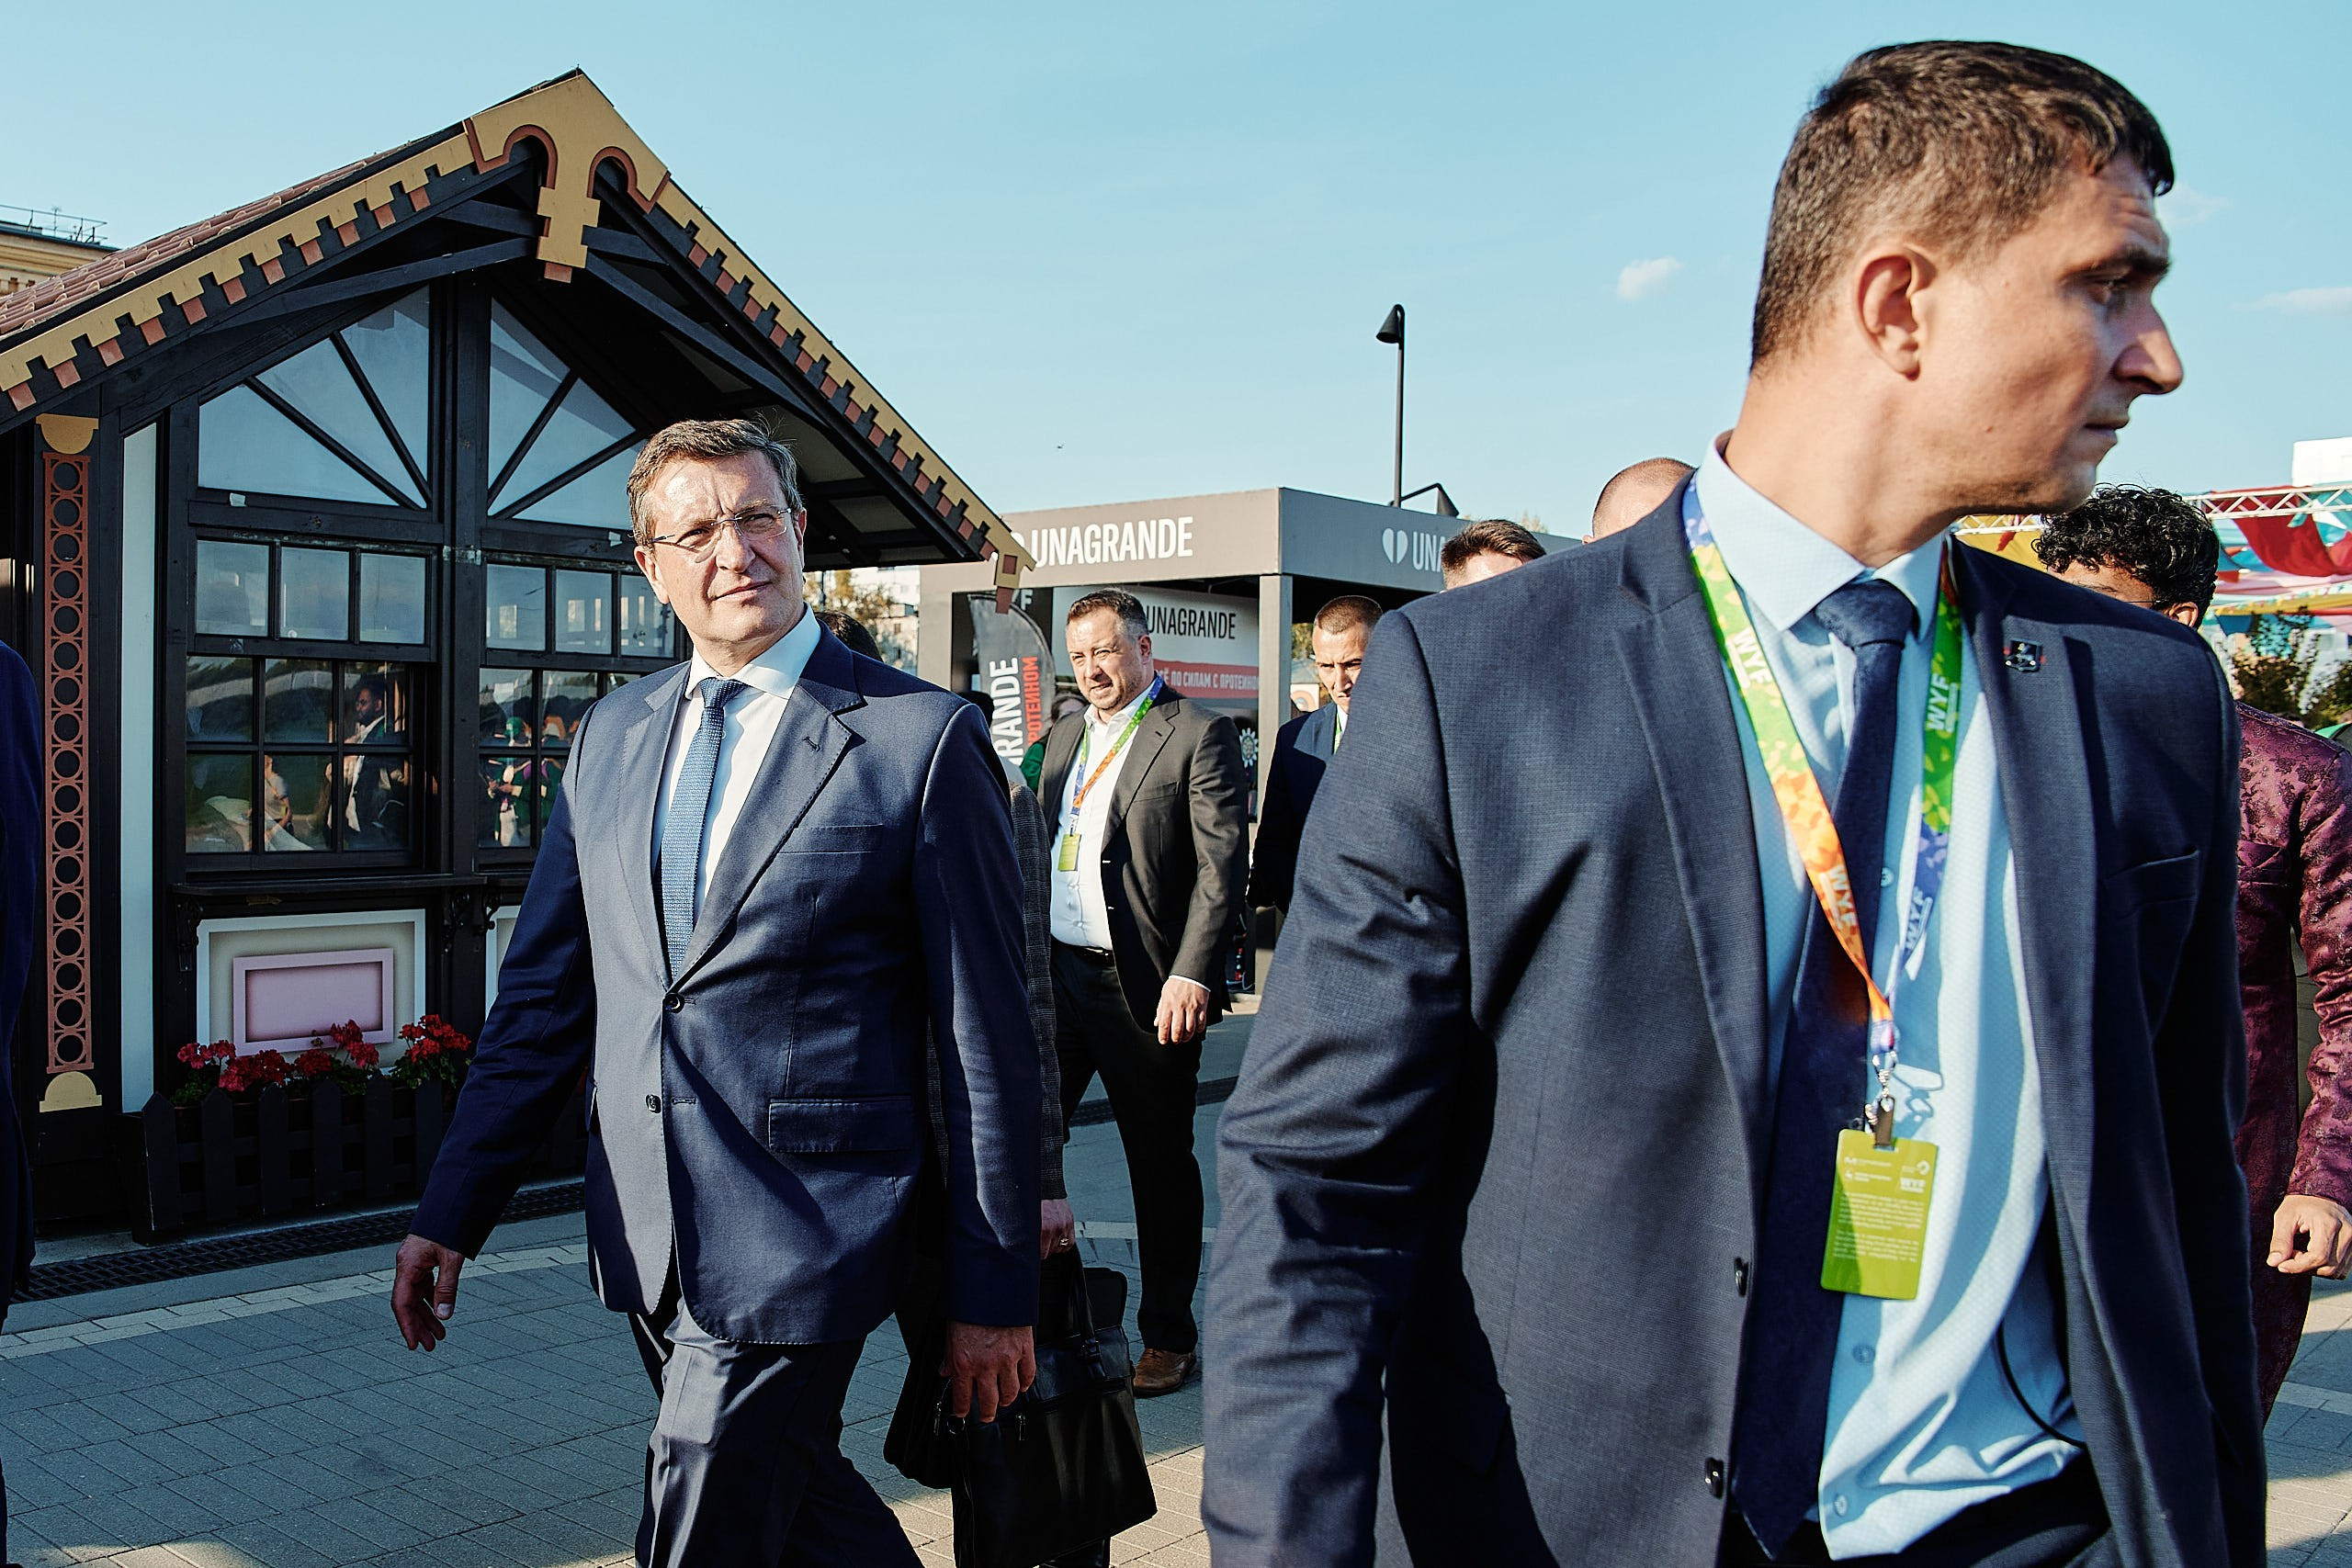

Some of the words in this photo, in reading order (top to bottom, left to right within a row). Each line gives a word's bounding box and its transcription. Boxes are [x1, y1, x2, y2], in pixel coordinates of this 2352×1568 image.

[1032, 516, 1193, 568] UNAGRANDE
[1146, 606, 1236, 639] UNAGRANDE
[1219, 673, 1259, 691] ПРОТЕИНО
[1733, 626, 1773, 684] WYF
[1928, 672, 1950, 730] WYF
[1828, 863, 1857, 927] WYF
